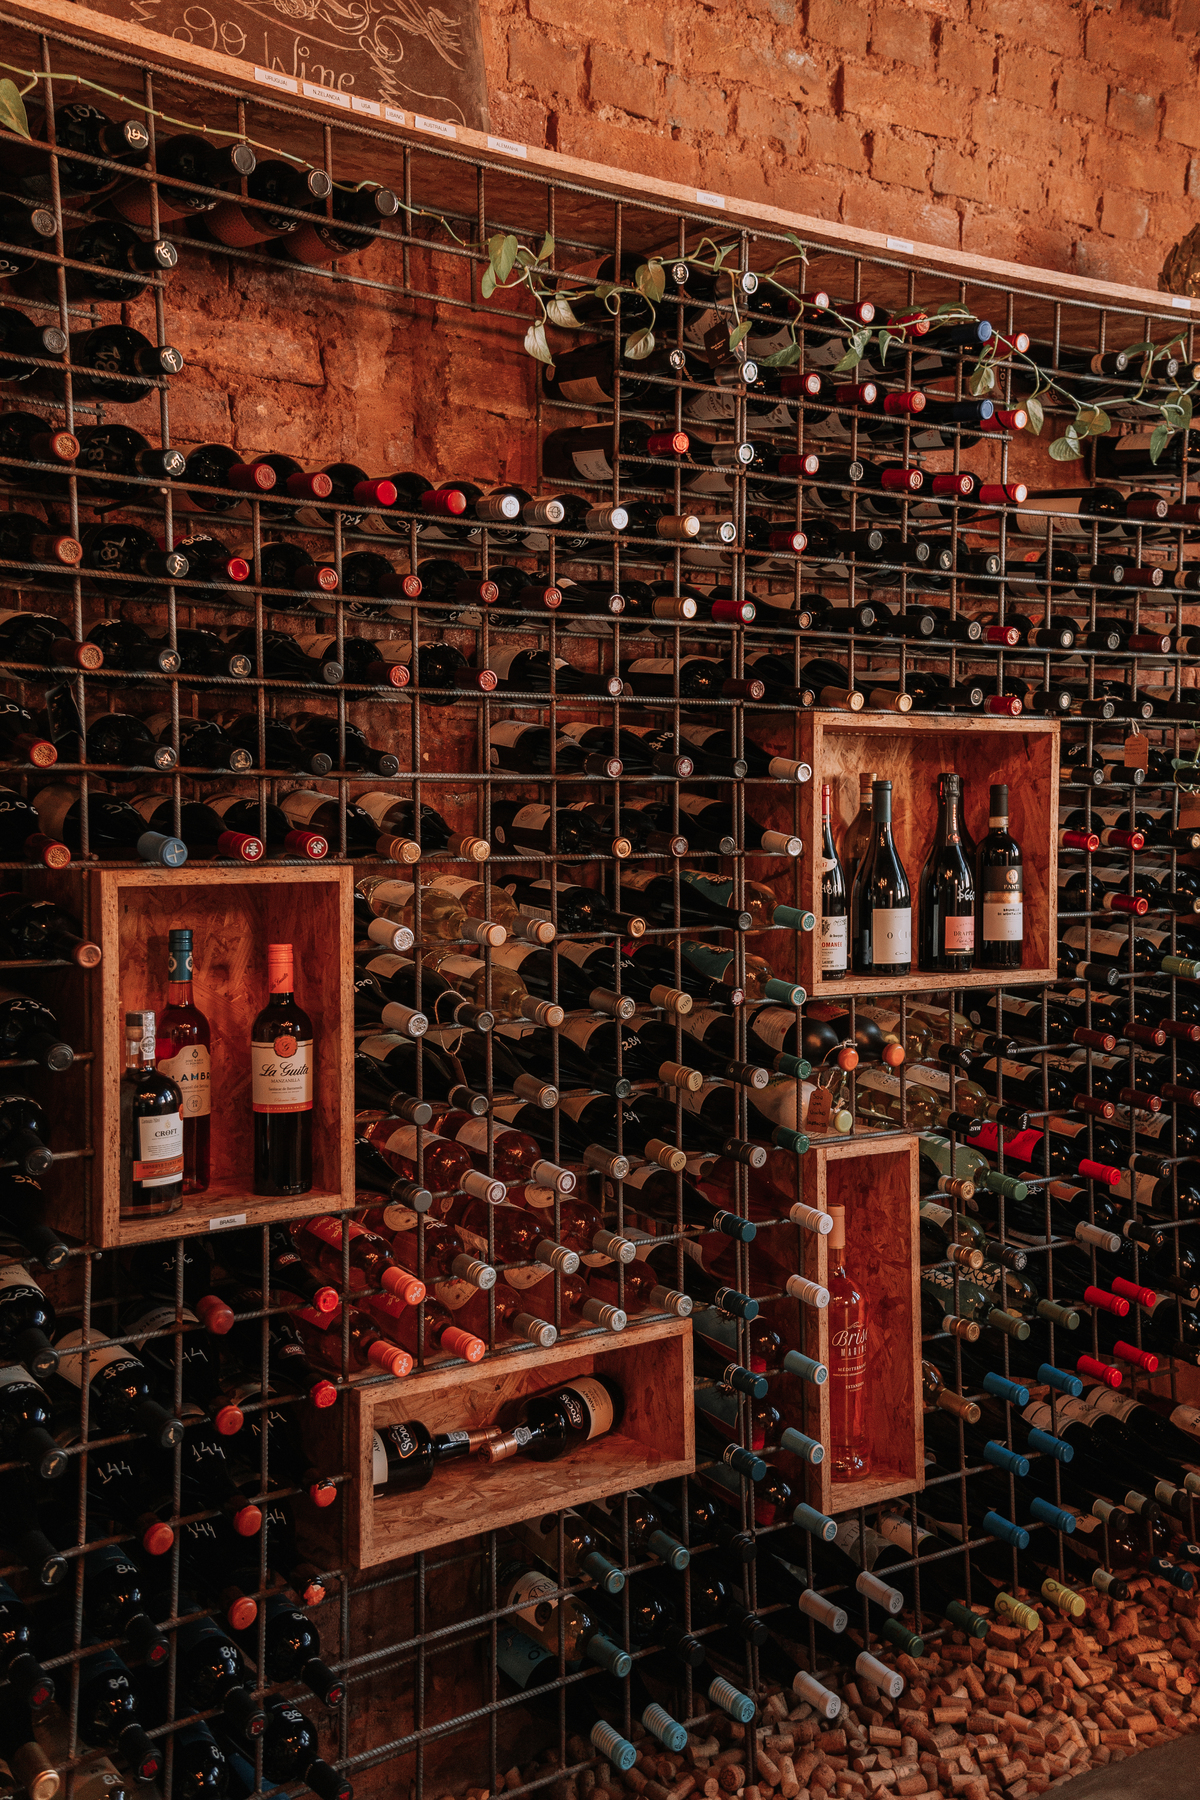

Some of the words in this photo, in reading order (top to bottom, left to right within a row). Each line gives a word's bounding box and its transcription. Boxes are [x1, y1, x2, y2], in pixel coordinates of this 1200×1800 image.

[264, 74, 288, 86] URUGUAI
[312, 88, 340, 101] N.ZELANDIA
[360, 102, 371, 110] USA
[387, 111, 403, 121] LIBANO
[423, 121, 448, 133] AUSTRALIA
[319, 573, 337, 586] SIMI
[621, 1035, 642, 1051] 284
[259, 1063, 277, 1077] La
[279, 1061, 309, 1077] Guita
[172, 1072, 210, 1083] LAMBR
[613, 1110, 641, 1125] 84
[155, 1128, 177, 1137] CROFT
[219, 1218, 237, 1226] BRASIL
[580, 1389, 596, 1412] TAWNY
[191, 1441, 226, 1462] 144
[97, 1460, 133, 1485] 144
[115, 1563, 137, 1574] 84
[836, 1617, 845, 1627] 22
[220, 1644, 238, 1658] 84
[108, 1675, 130, 1689] 84
